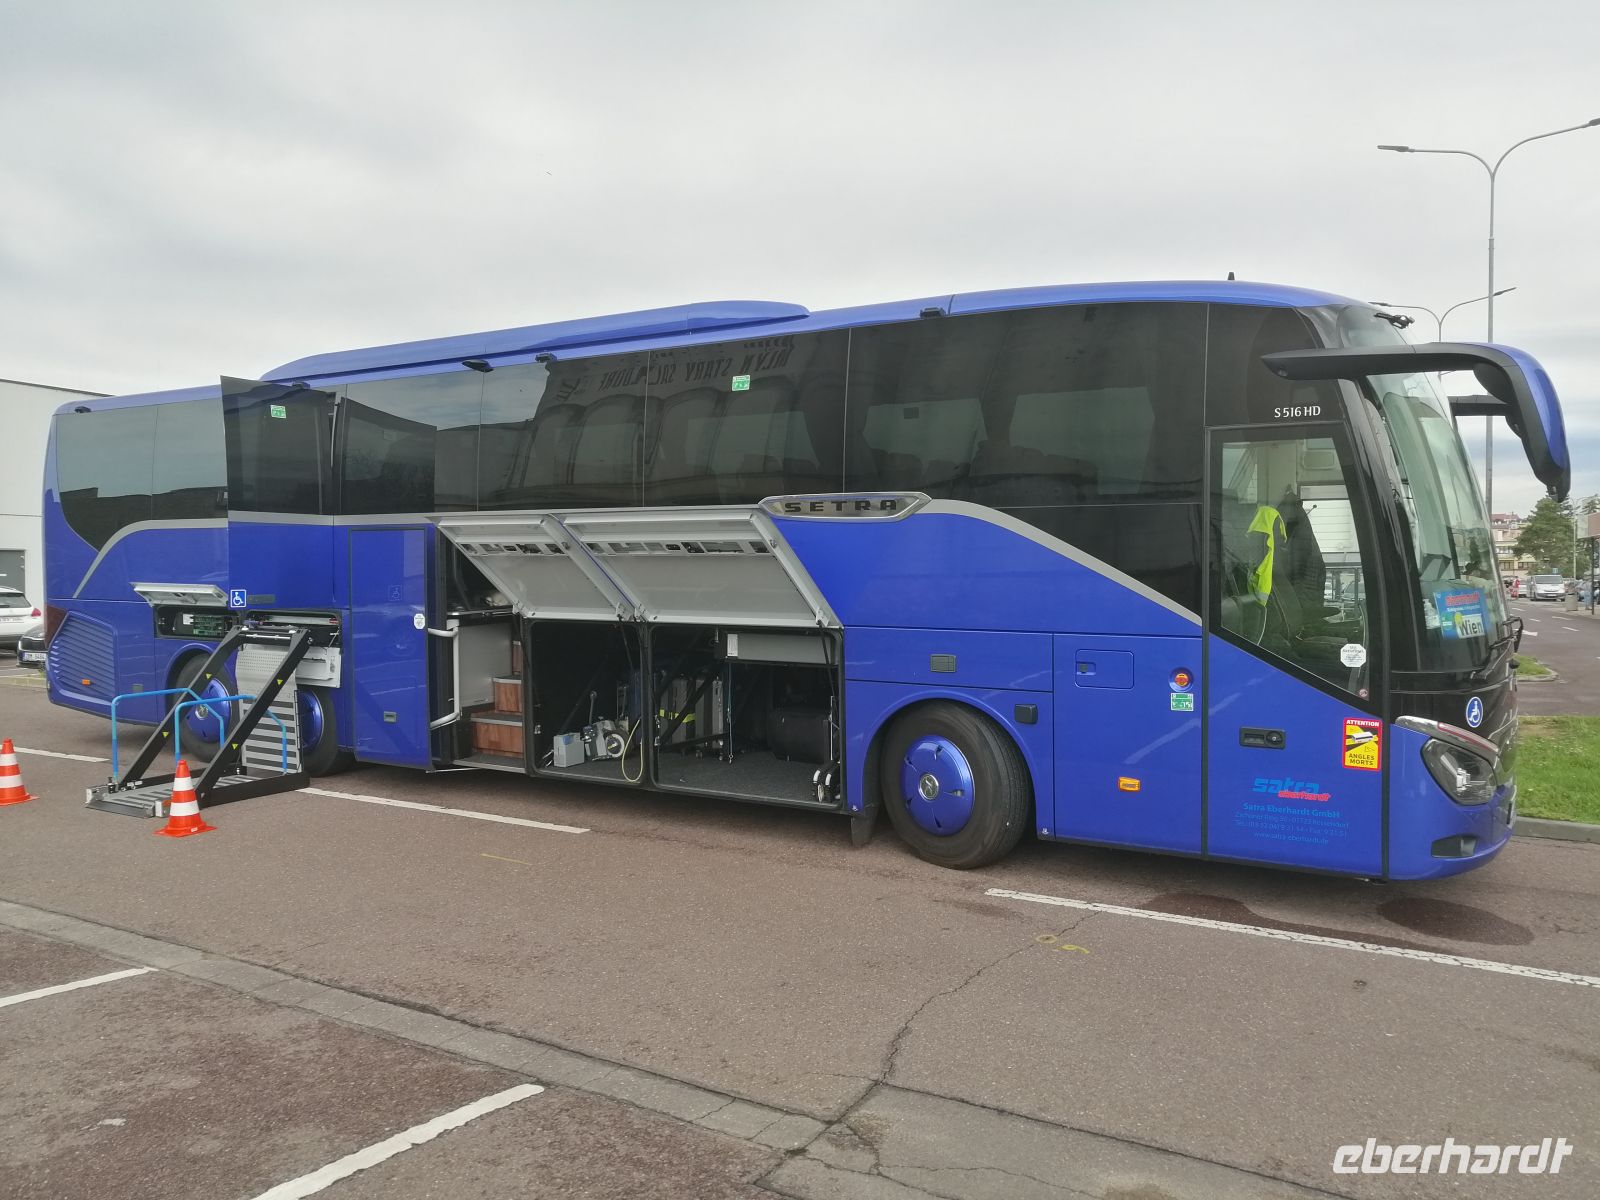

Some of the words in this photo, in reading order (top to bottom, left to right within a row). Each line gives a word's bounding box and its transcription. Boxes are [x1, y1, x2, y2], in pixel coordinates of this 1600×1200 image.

[1283, 406, 1302, 418] 516
[1303, 405, 1321, 417] HD
[784, 499, 898, 513] SETRA
[1459, 619, 1484, 636] Wien
[1346, 719, 1380, 727] ATTENTION
[1349, 753, 1375, 761] ANGLES
[1311, 808, 1341, 819] GmbH
